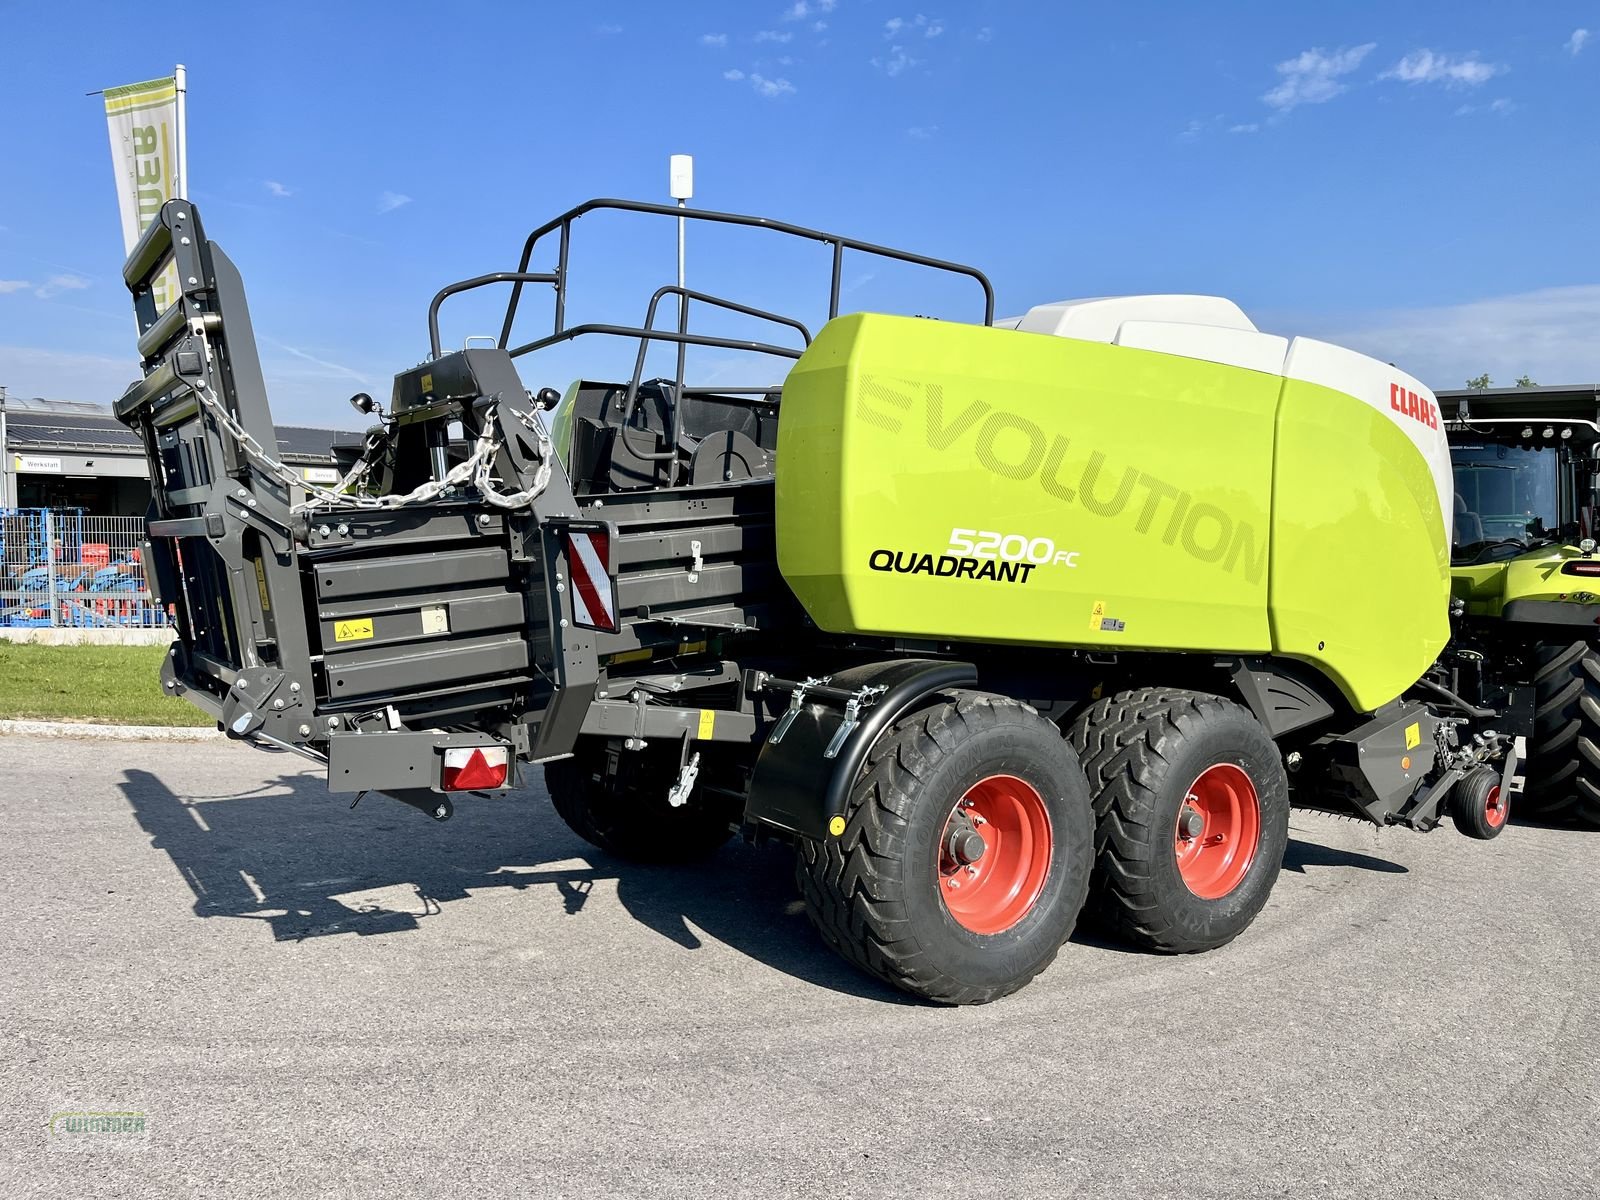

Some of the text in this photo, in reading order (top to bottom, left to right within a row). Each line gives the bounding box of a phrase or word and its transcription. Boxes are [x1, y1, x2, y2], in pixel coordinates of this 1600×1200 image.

[1390, 382, 1437, 430] CLAAS
[856, 374, 1267, 586] EVOLUTION
[869, 549, 1036, 583] QUADRANT
[946, 527, 1080, 568] 5200 FC
